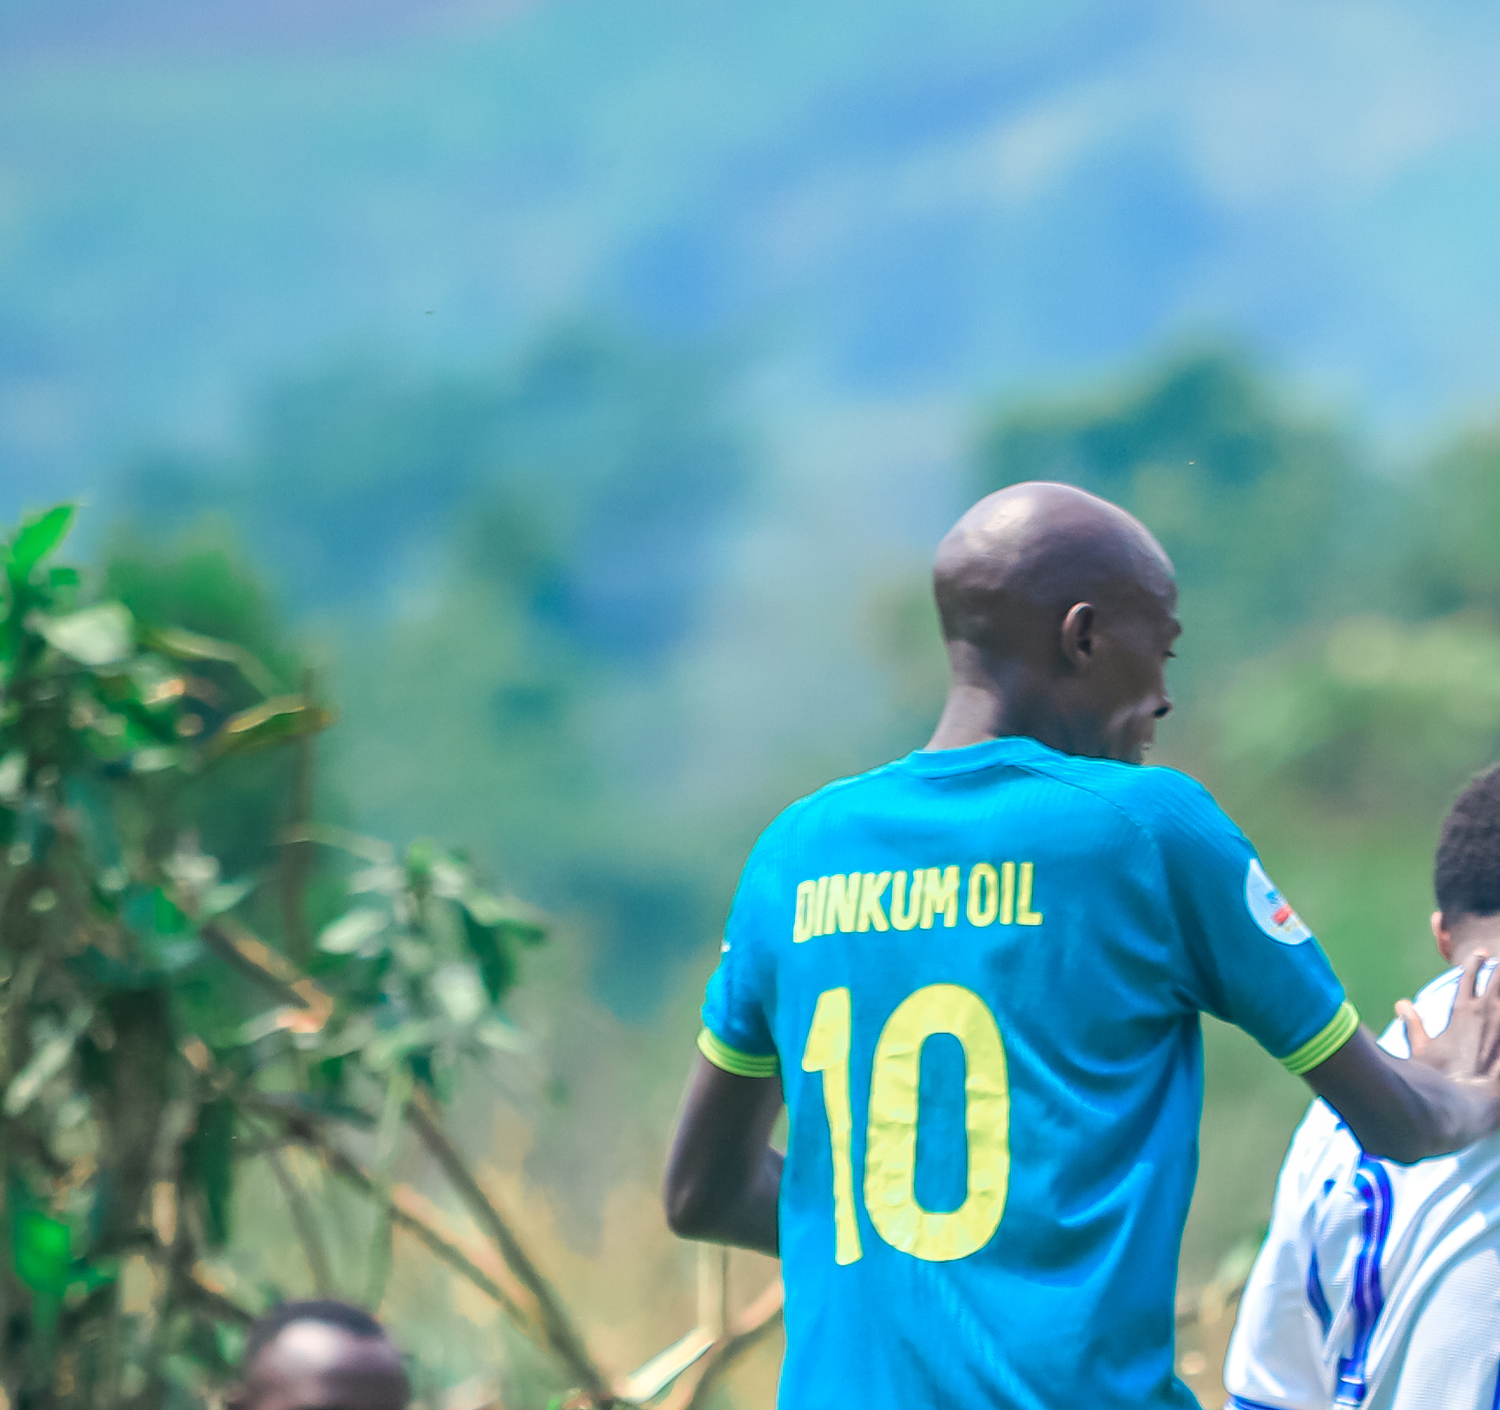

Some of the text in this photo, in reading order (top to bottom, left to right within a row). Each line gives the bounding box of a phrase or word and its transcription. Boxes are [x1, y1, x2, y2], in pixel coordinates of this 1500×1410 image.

[792, 861, 1043, 944] DINKUM OIL
[801, 983, 1011, 1266] 10
